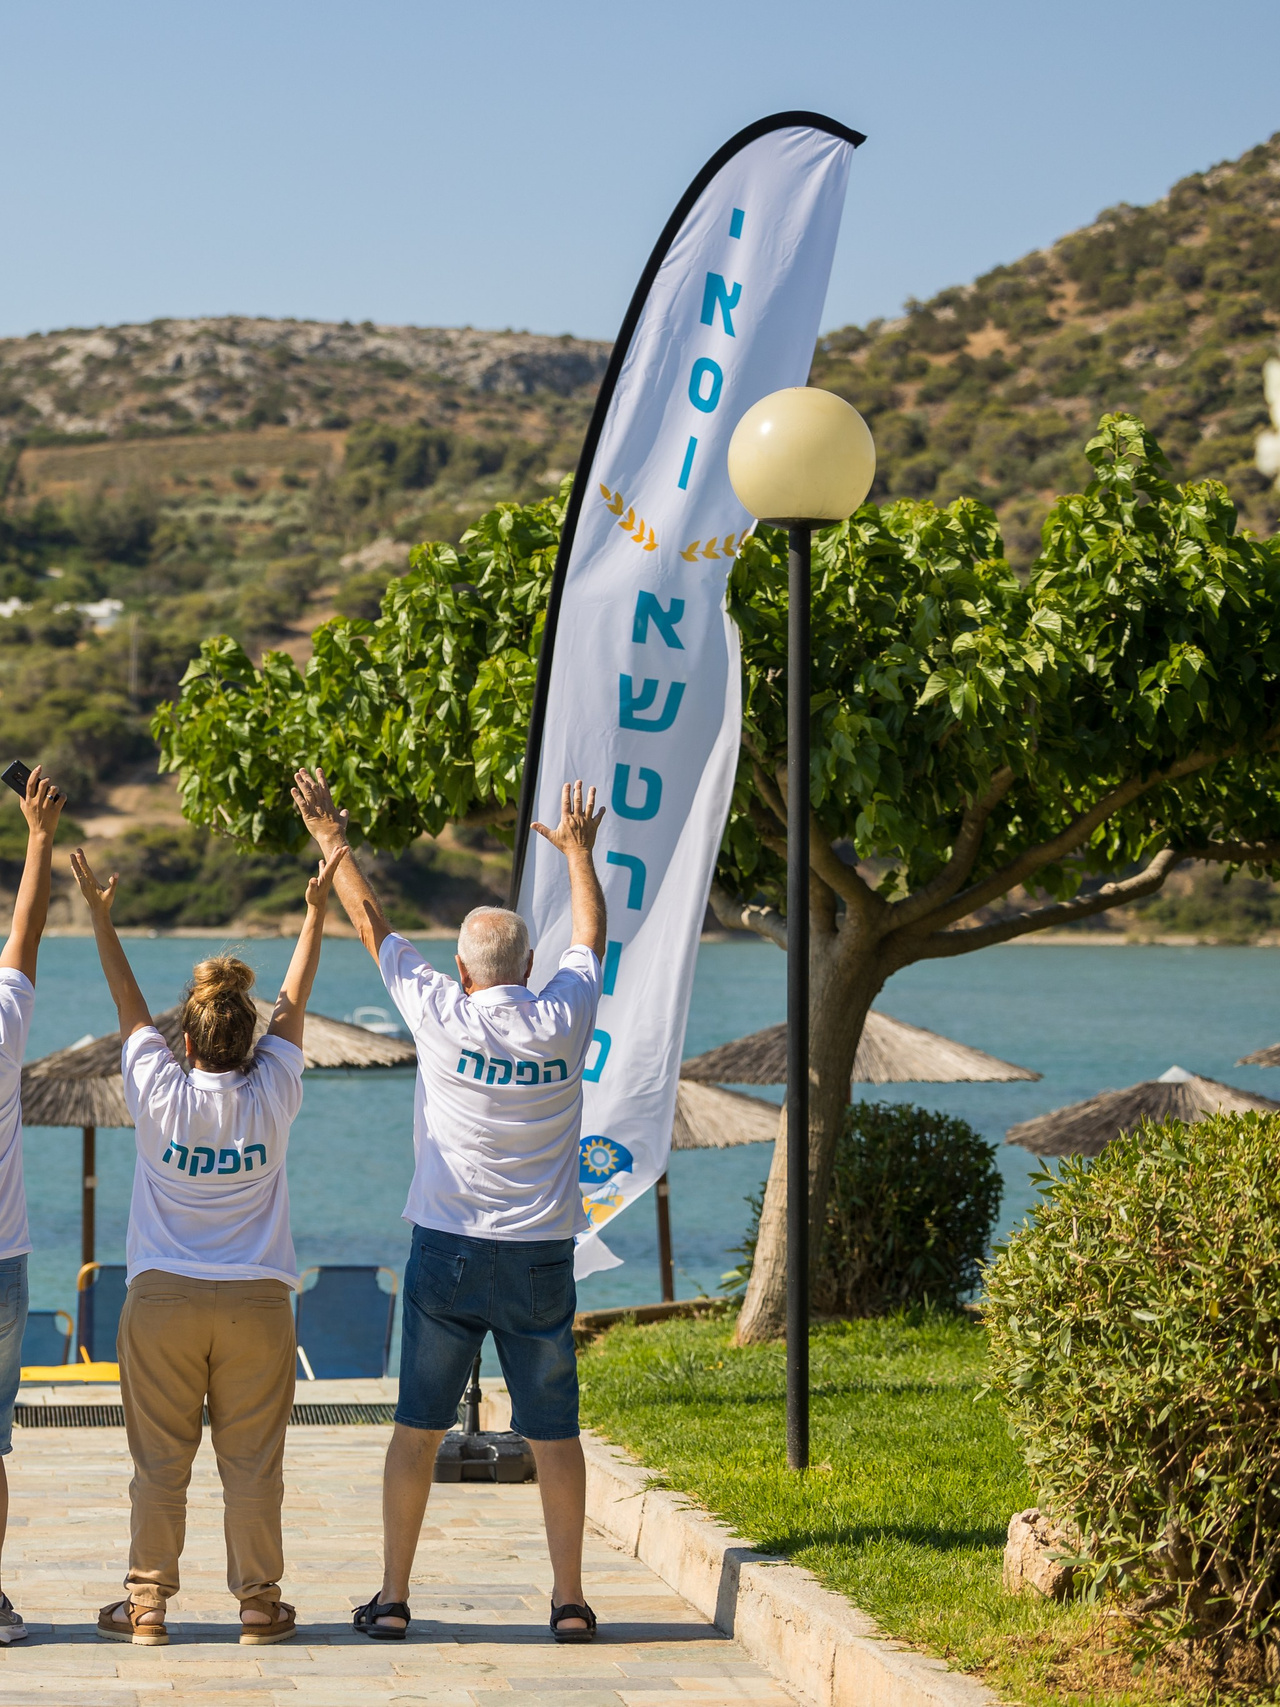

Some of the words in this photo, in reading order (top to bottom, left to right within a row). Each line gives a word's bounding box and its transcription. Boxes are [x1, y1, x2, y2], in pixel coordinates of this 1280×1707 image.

[677, 207, 746, 491] יאסו
[456, 1048, 568, 1086] הפקה
[162, 1139, 267, 1177] הפקה
